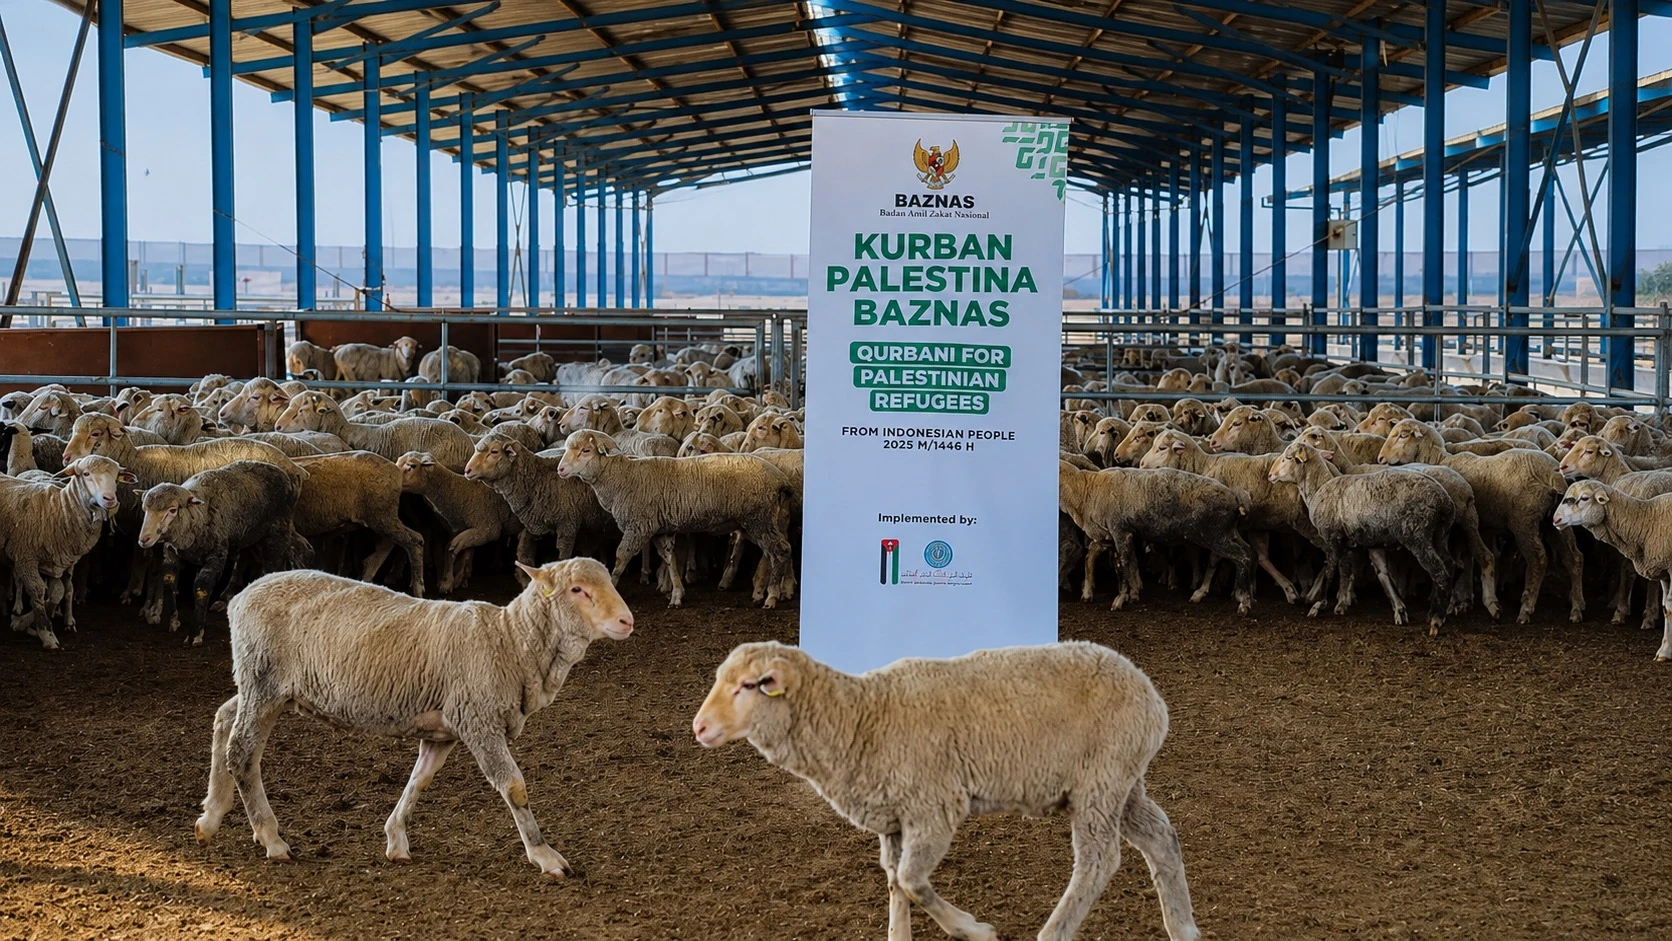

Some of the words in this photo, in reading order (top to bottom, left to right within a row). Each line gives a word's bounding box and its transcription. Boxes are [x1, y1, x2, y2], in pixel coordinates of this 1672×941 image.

[895, 194, 975, 209] BAZNAS
[880, 209, 906, 217] Badan
[908, 209, 928, 218] Amil
[929, 210, 953, 218] Zakat
[954, 210, 990, 219] Nasional
[854, 232, 1013, 261] KURBAN
[826, 265, 1038, 293] PALESTINA
[853, 299, 1010, 327] BAZNAS
[857, 345, 955, 363] QURBANI
[962, 348, 1004, 365] FOR
[860, 369, 1000, 388] PALESTINIAN
[875, 393, 985, 411] REFUGEES
[842, 426, 879, 437] FROM
[882, 427, 964, 439] INDONESIAN
[968, 430, 1016, 441] PEOPLE
[883, 440, 914, 450] 2025
[917, 440, 962, 451] M/1446
[966, 442, 975, 451] H
[878, 513, 956, 524] Implemented
[959, 515, 977, 526] by:
